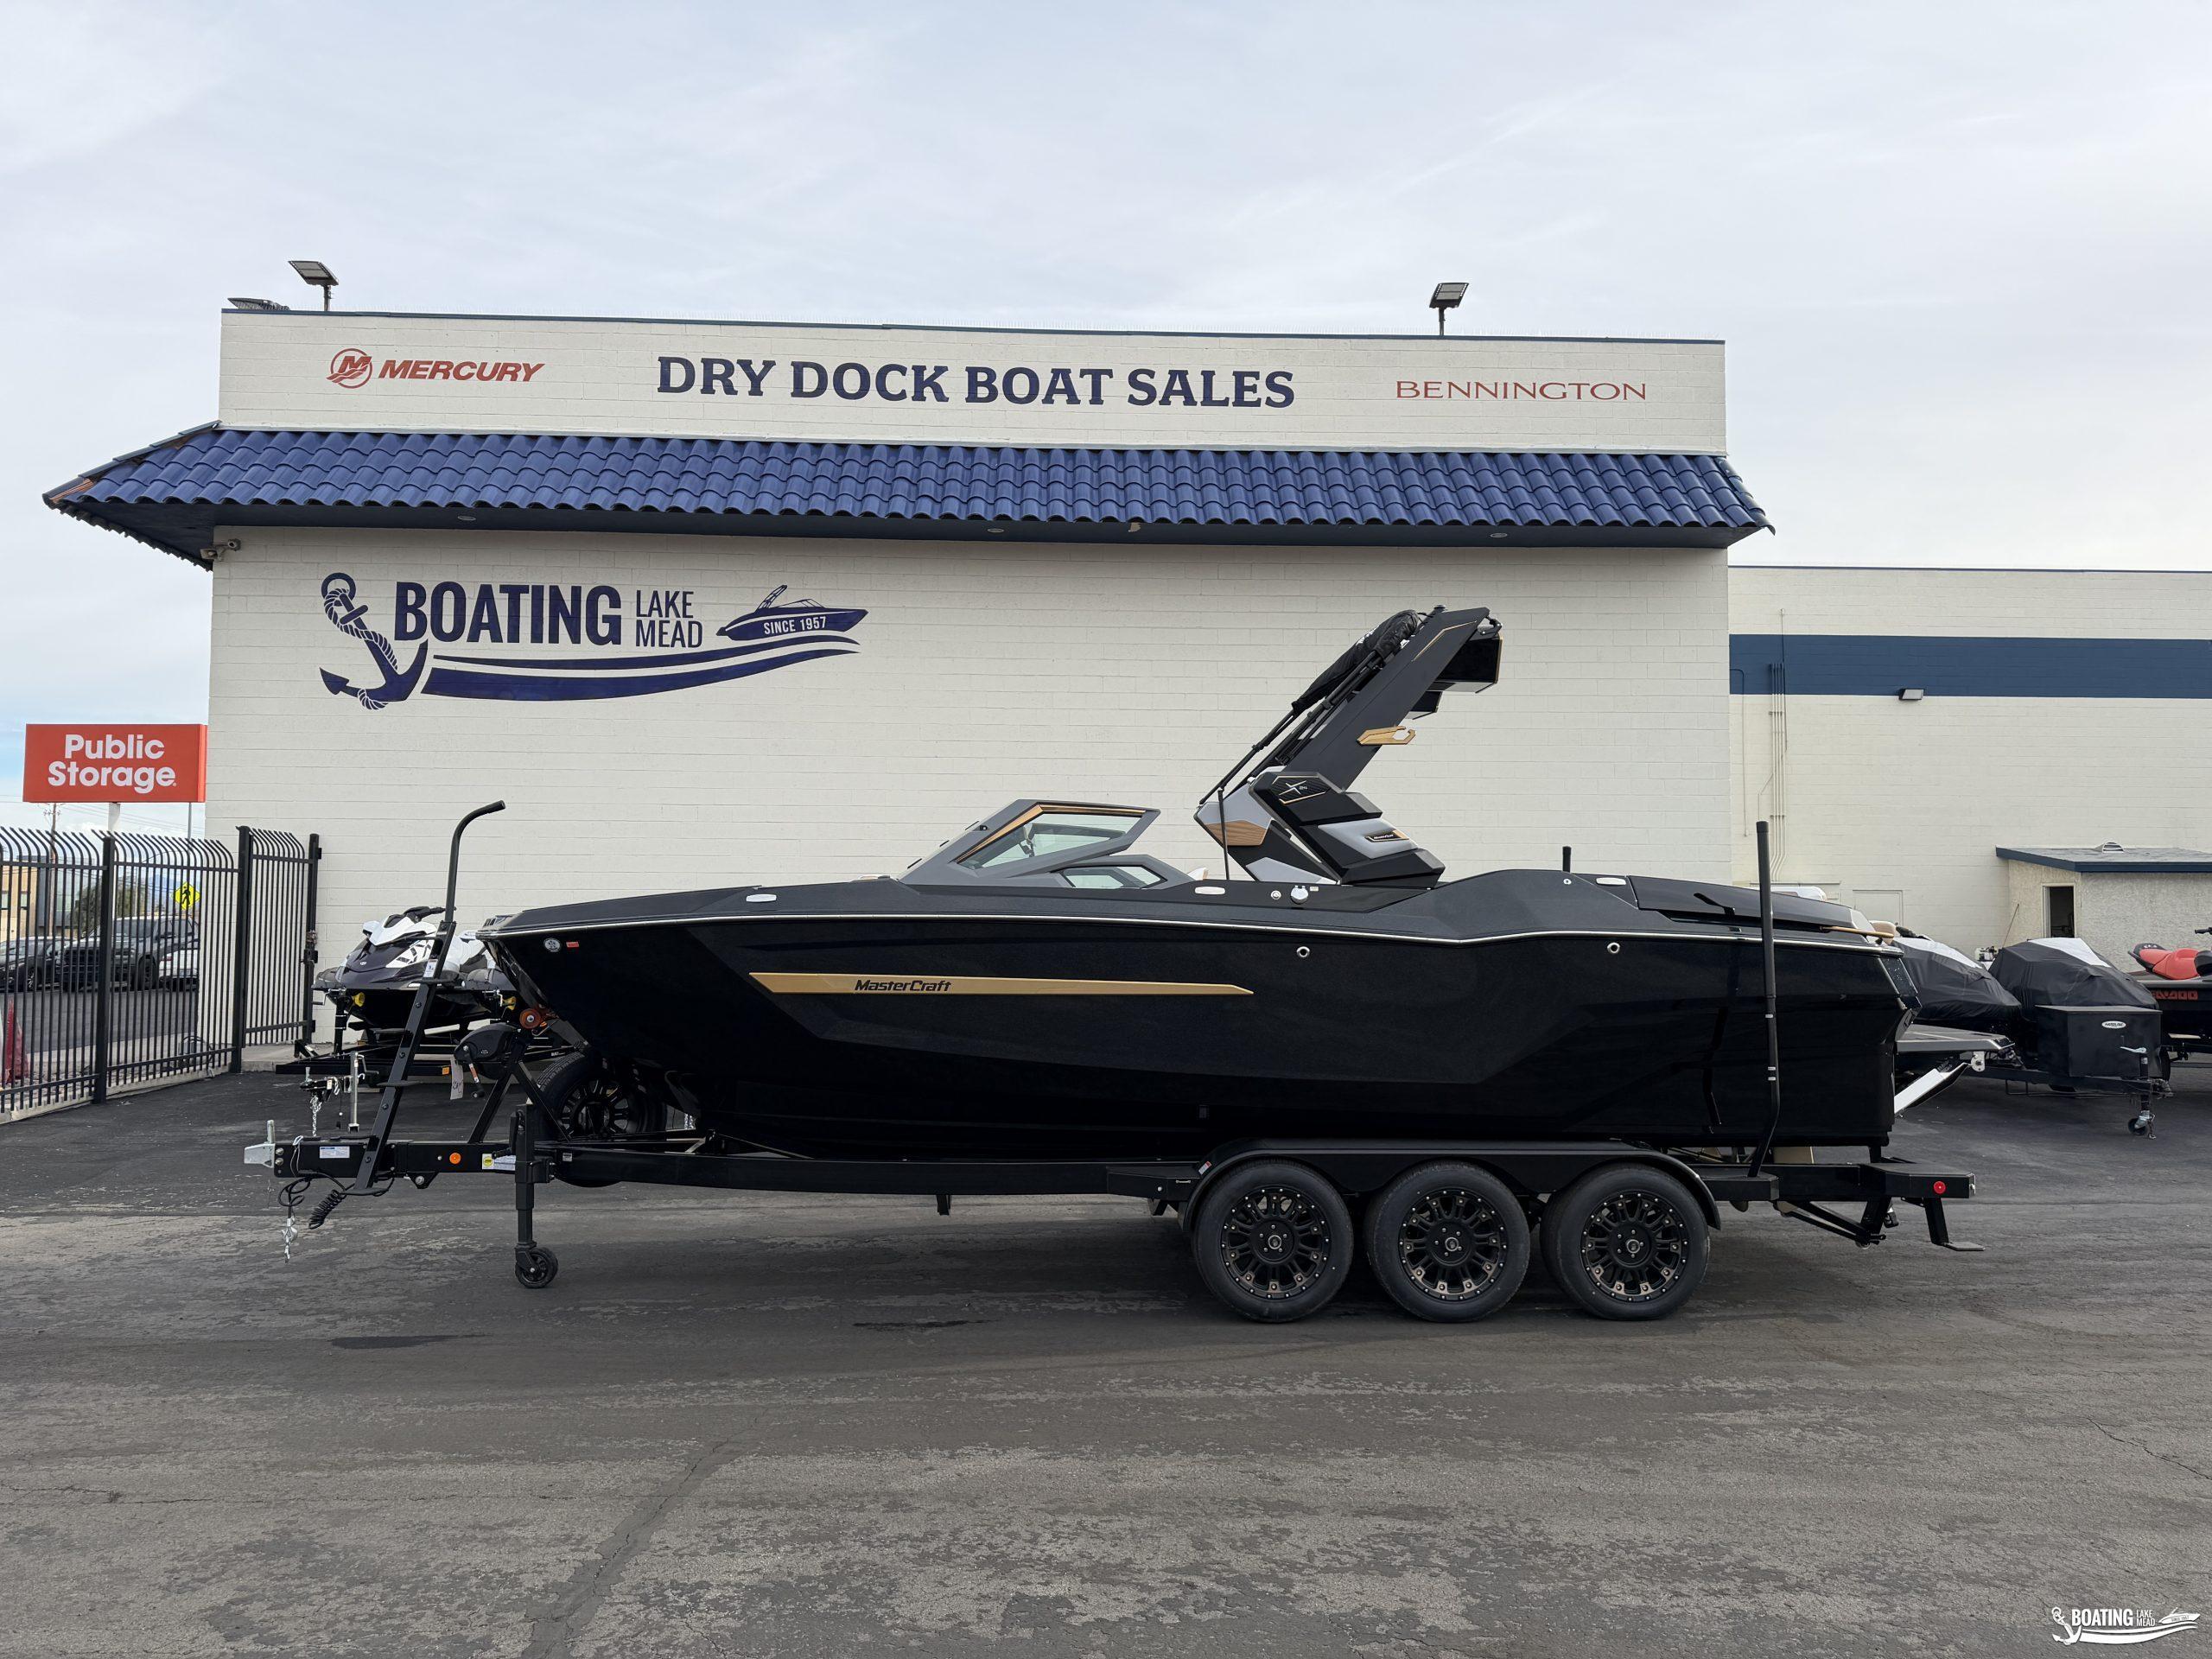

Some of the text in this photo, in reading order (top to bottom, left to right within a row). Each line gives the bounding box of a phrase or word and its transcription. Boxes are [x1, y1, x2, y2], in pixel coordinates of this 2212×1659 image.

[378, 359, 545, 382] MERCURY
[658, 356, 1294, 408] DRY DOCK BOAT SALES
[1396, 380, 1646, 400] BENNINGTON
[394, 581, 621, 645] BOATING
[635, 589, 694, 619] LAKE
[635, 620, 703, 648] MEAD
[764, 616, 827, 635] SINCE 1957
[65, 734, 165, 760] Public
[48, 761, 176, 794] Storage
[855, 980, 951, 991] MasterCraft
